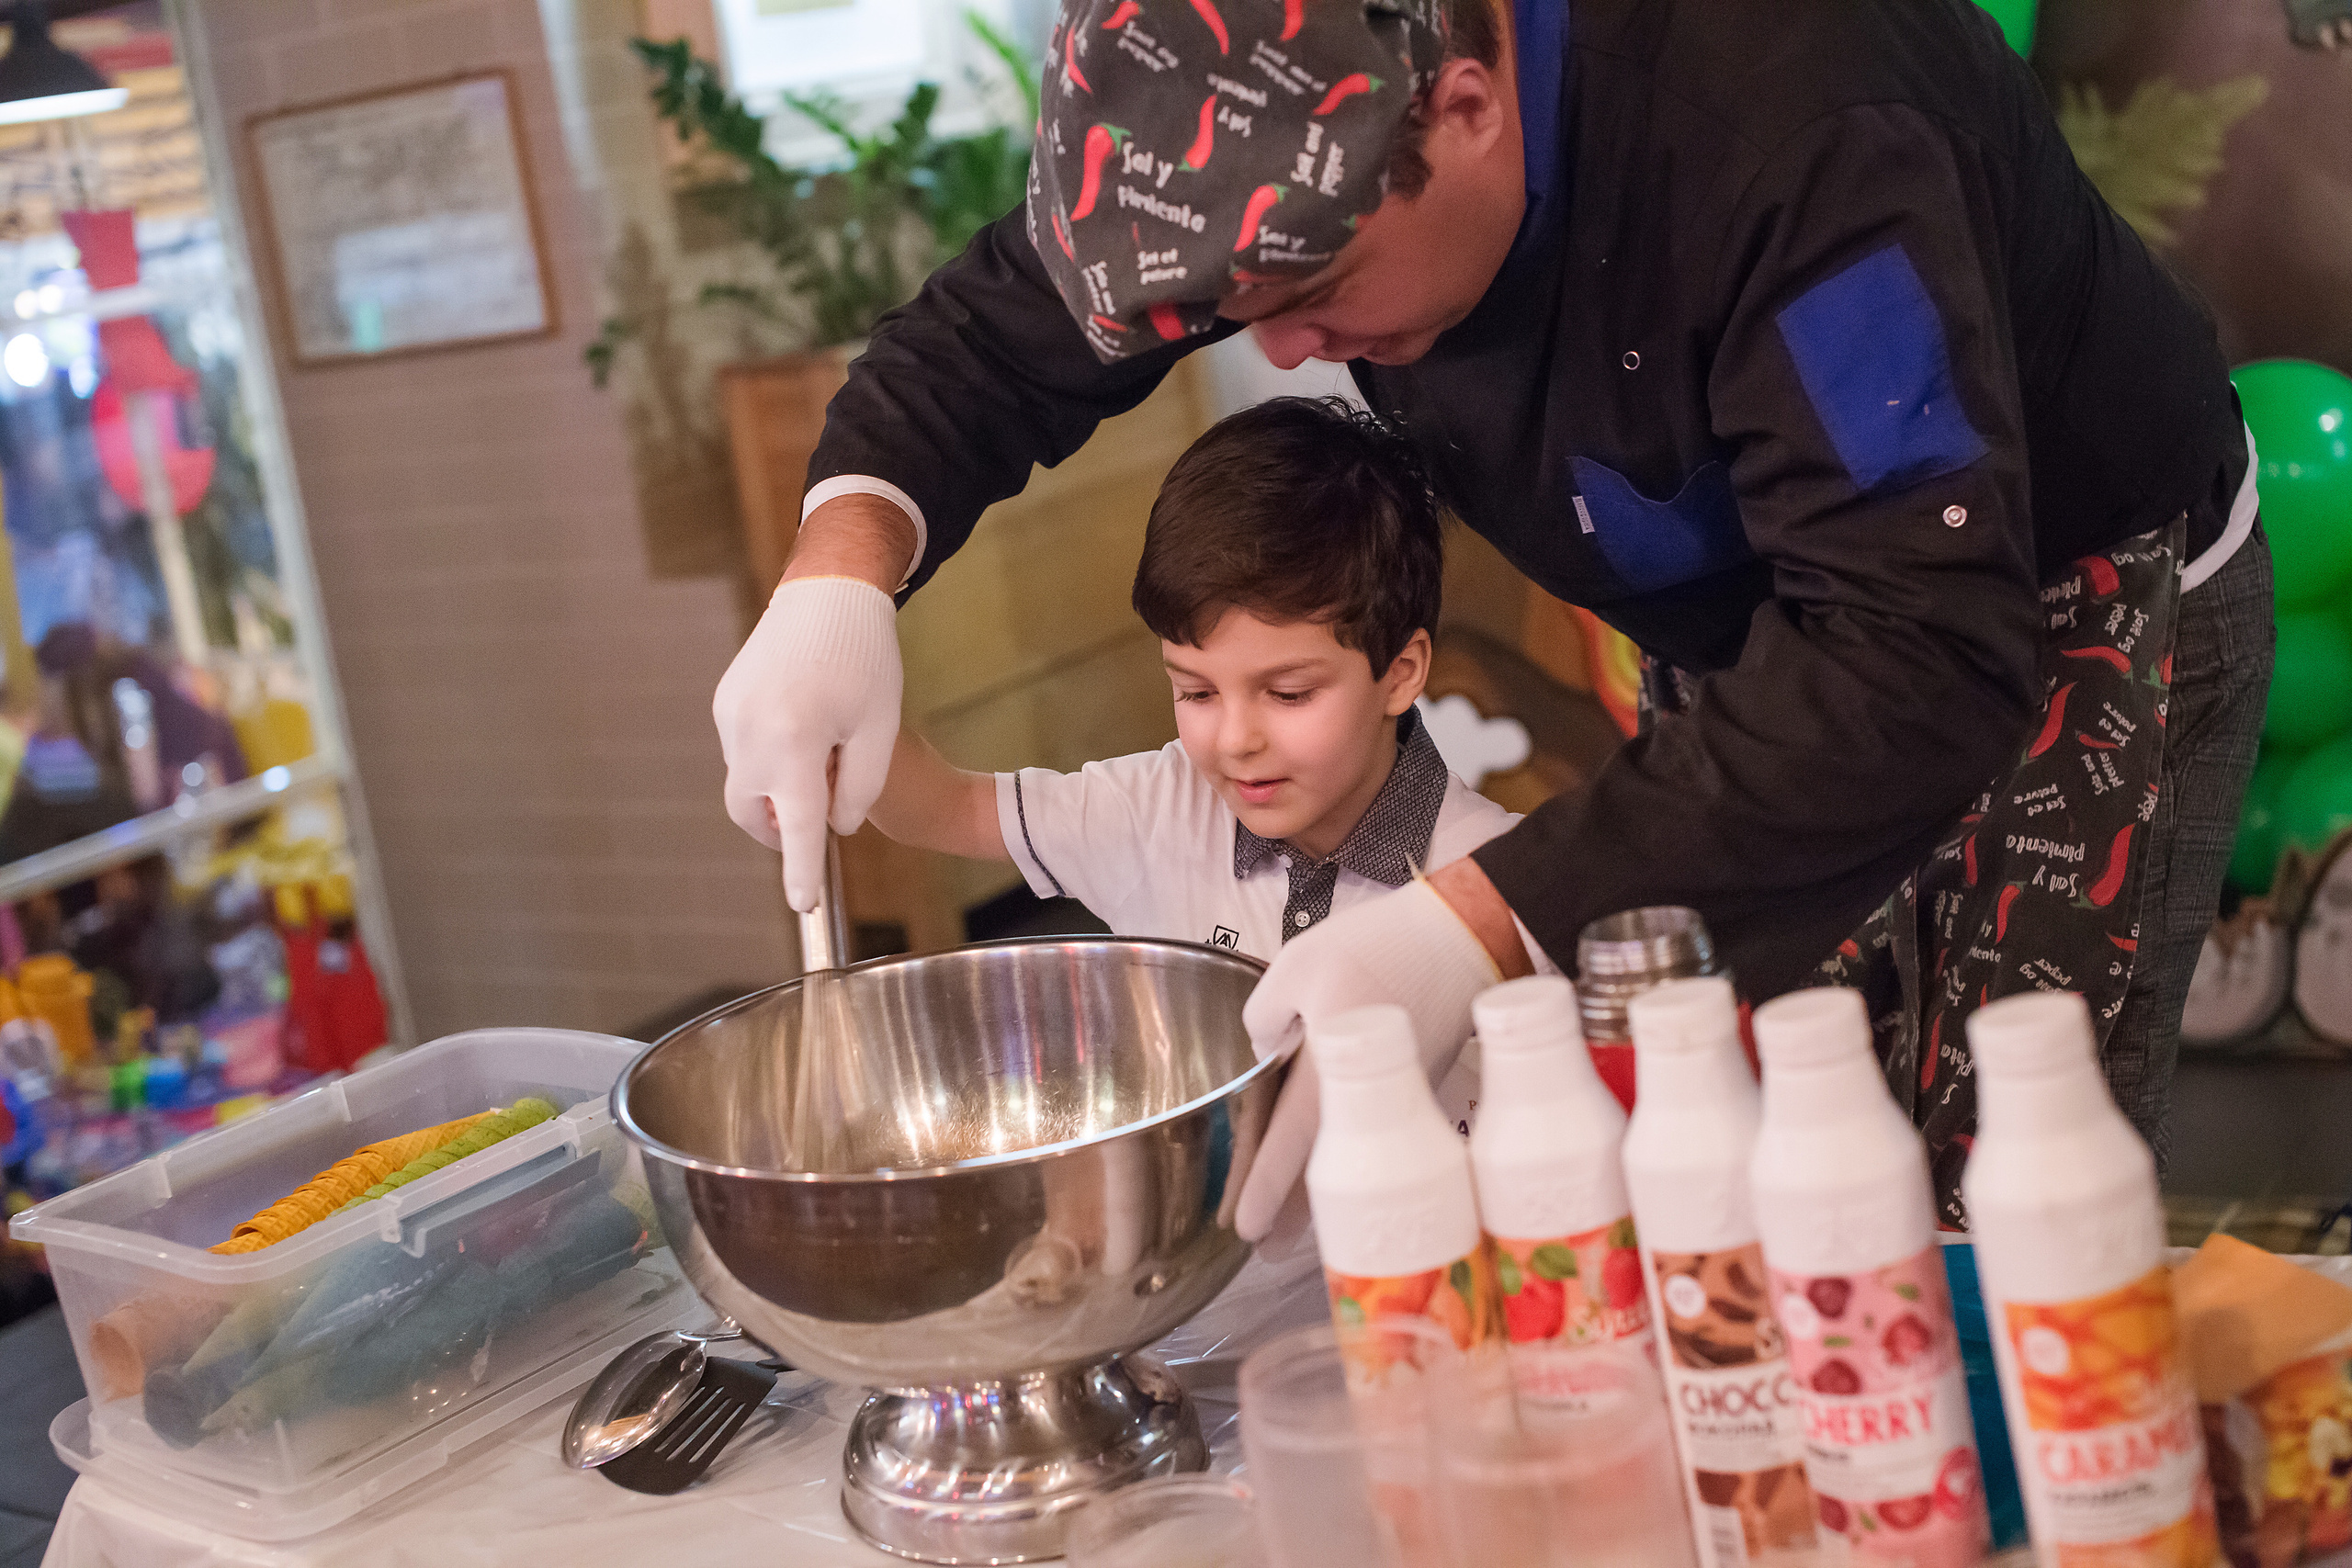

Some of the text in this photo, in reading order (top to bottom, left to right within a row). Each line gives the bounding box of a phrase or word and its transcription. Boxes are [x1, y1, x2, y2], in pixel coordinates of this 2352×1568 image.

[1122, 141, 1174, 189] Sal y
[2005, 833, 2086, 863] pimienta
[2030, 864, 2081, 898] Sal y
